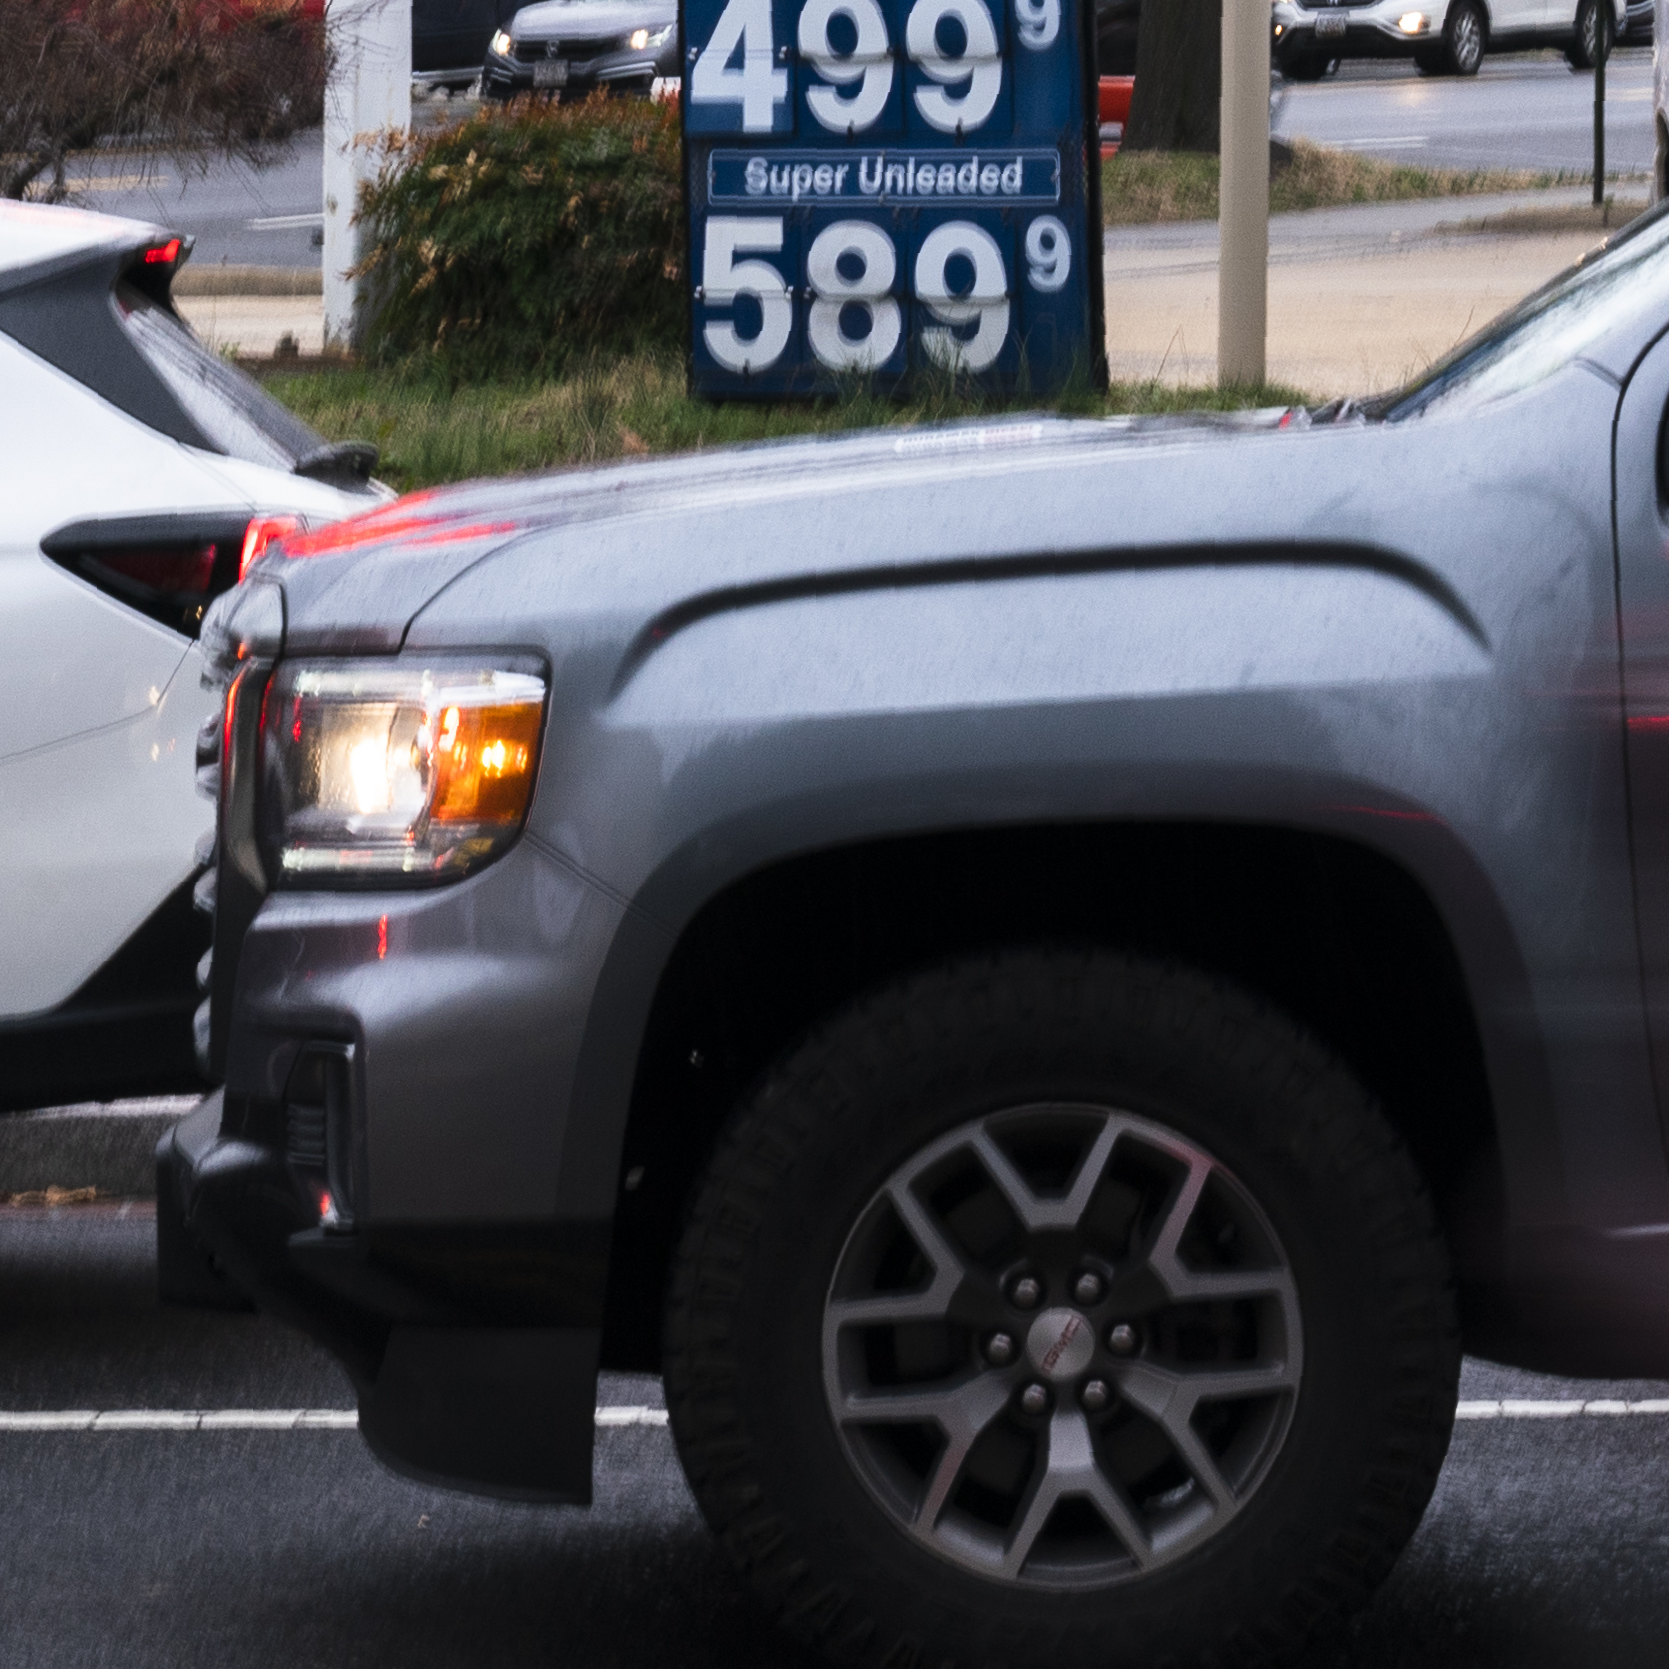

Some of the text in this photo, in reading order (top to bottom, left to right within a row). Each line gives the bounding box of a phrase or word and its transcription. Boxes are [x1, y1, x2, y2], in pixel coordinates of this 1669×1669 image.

[744, 155, 1024, 198] Super Unleaded
[702, 214, 1072, 374] 589 9
